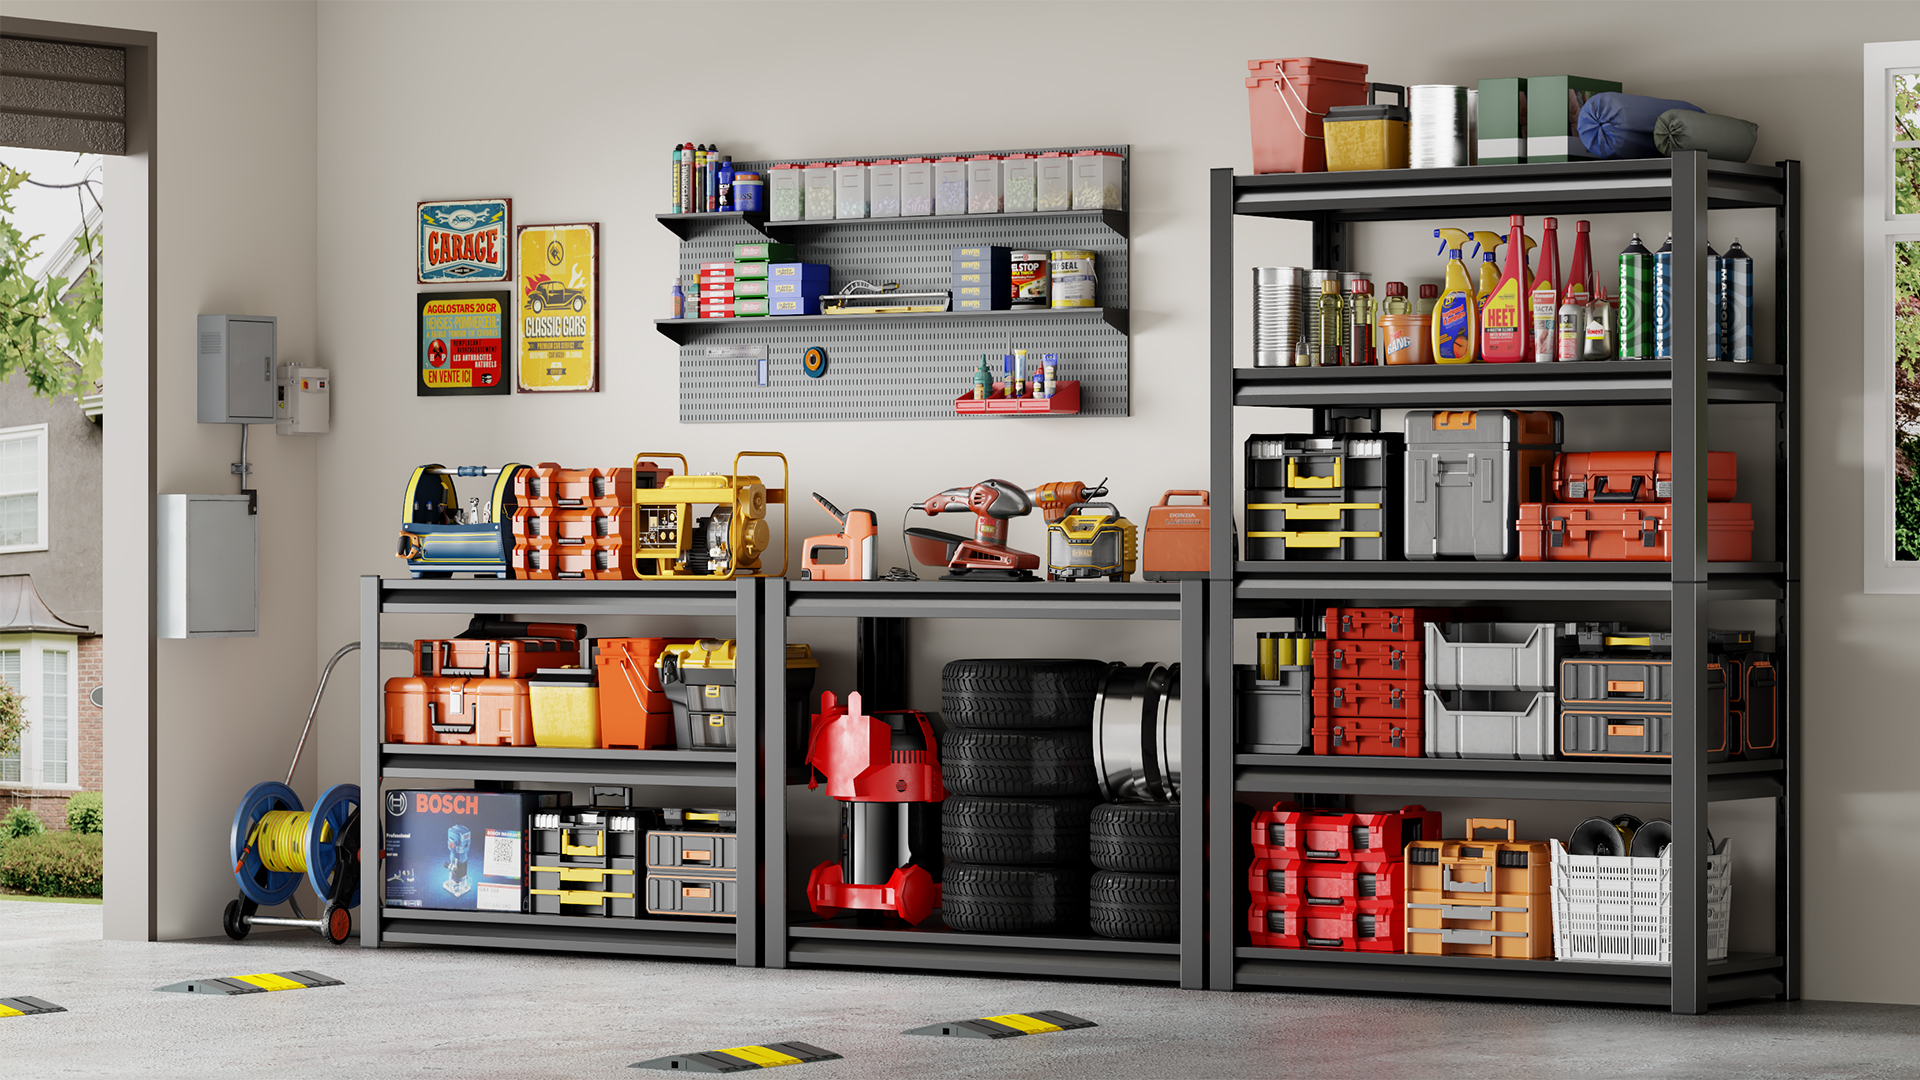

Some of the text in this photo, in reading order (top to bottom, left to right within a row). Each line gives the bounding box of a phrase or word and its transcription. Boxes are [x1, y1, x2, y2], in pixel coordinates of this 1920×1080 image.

[428, 228, 498, 266] GARAGE
[427, 303, 497, 314] AGGLOSTARS 20 GR
[1488, 308, 1515, 327] HEET
[477, 329, 498, 337] CENDRES
[525, 315, 586, 338] CLASSIC CARS
[1387, 337, 1411, 355] BANG
[441, 353, 446, 361] P
[428, 370, 471, 383] EN VENTE ICI
[416, 794, 479, 815] BOSCH
